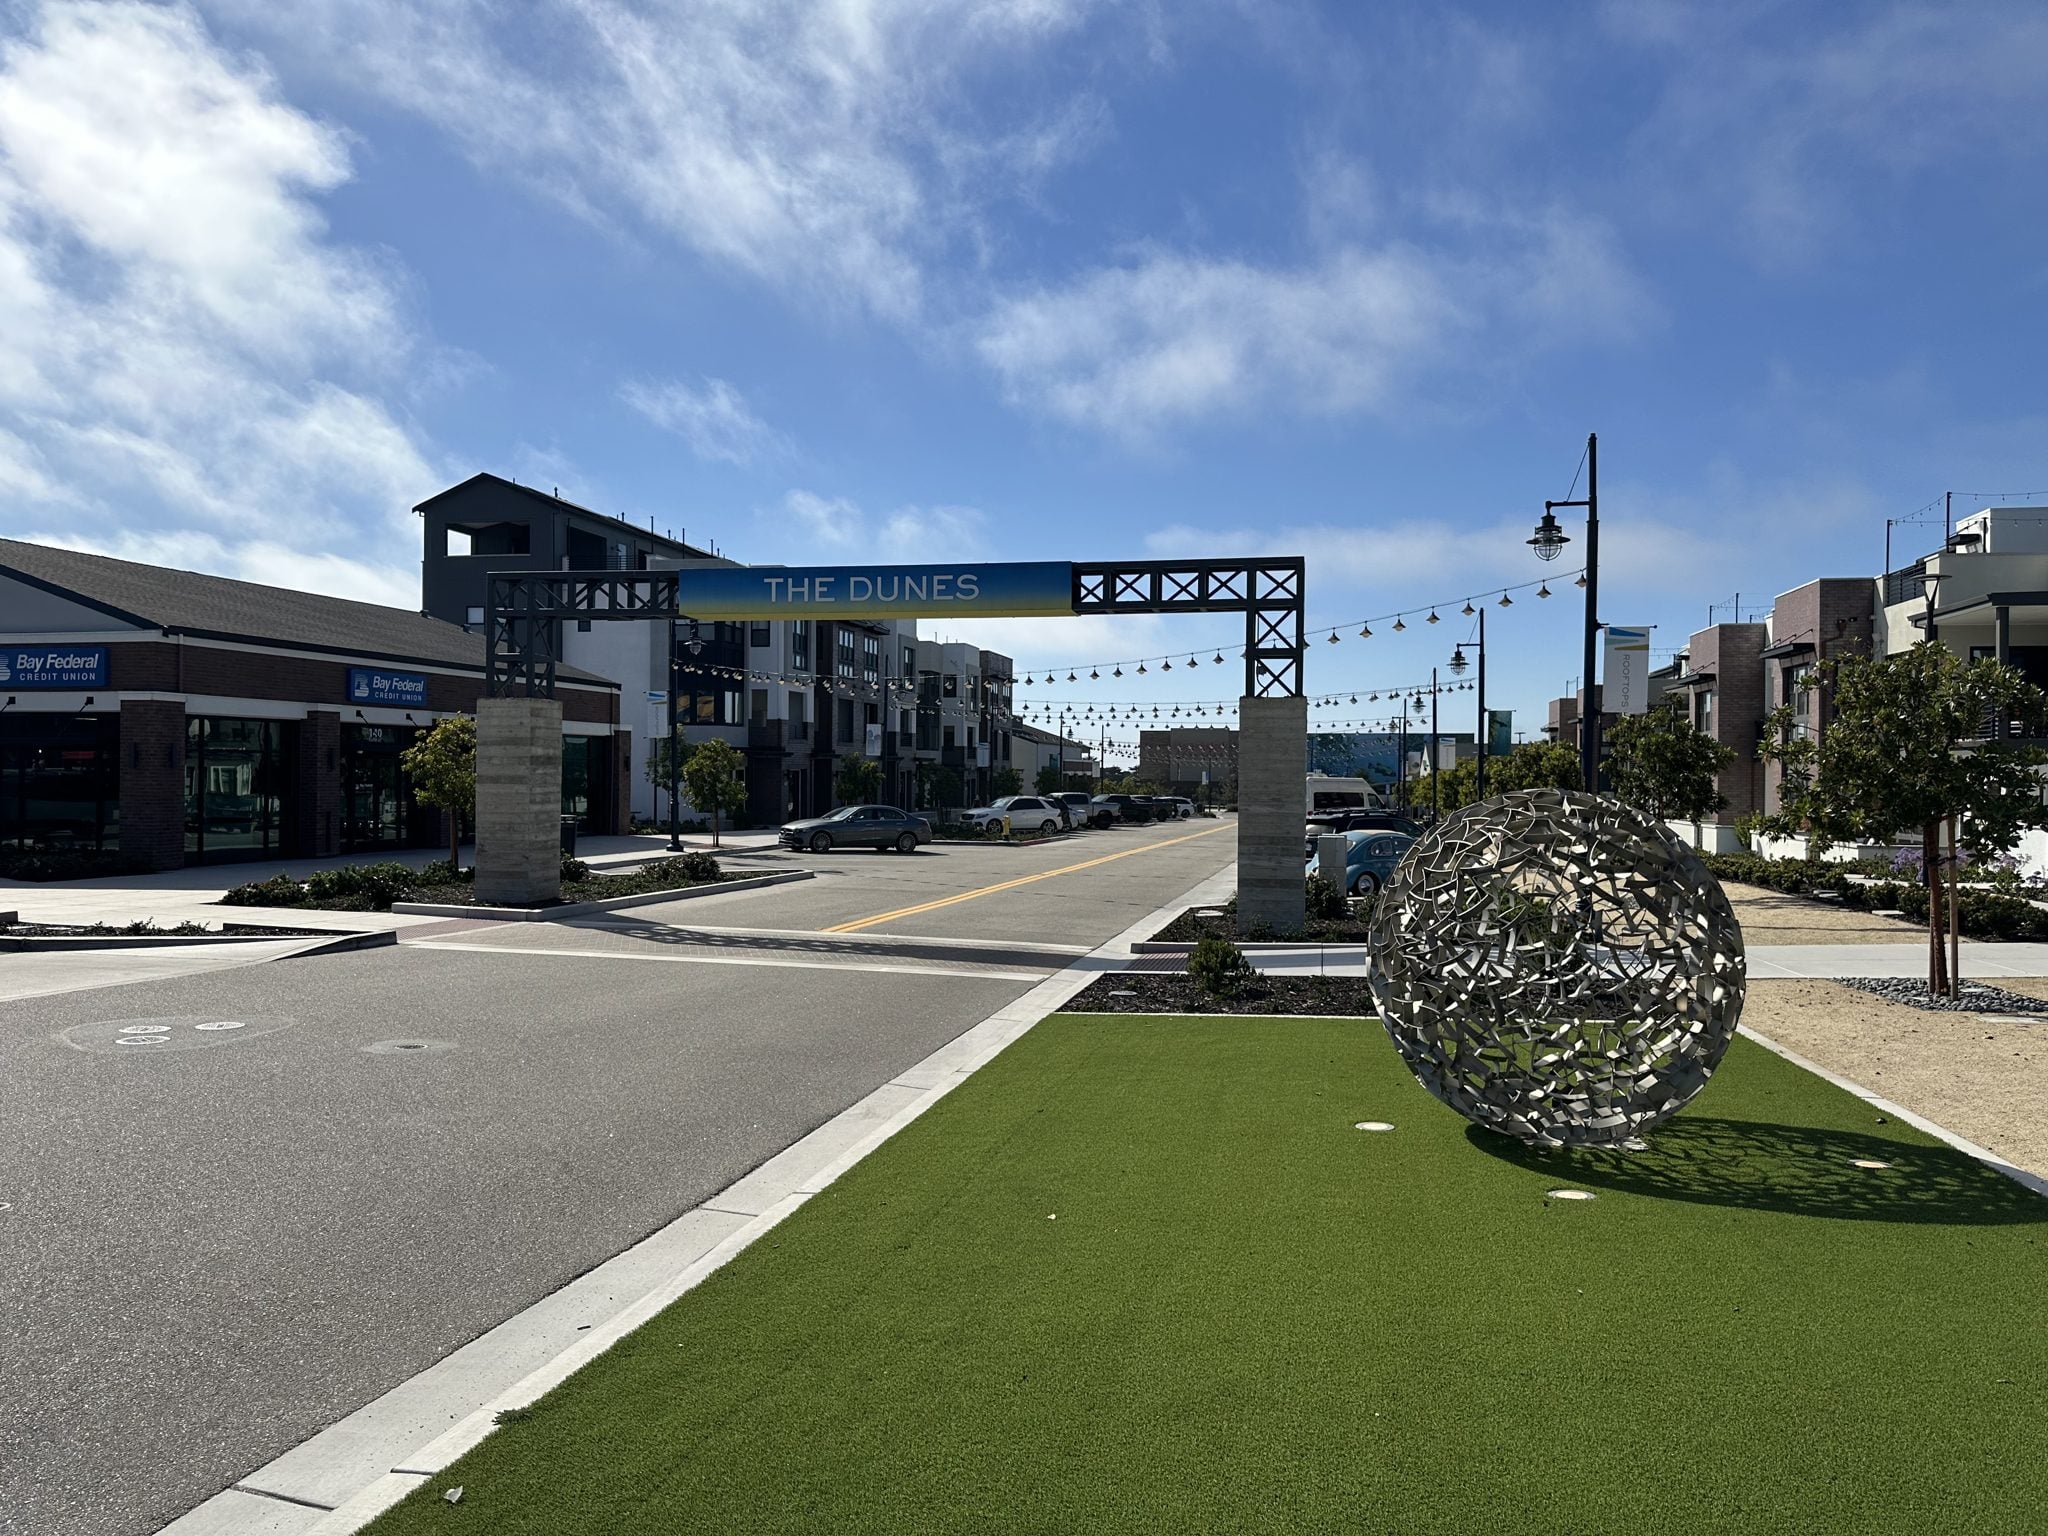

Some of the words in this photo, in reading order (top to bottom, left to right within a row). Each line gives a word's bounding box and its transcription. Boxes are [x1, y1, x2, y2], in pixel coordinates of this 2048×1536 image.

[763, 577, 835, 602] THE
[849, 574, 980, 601] DUNES
[16, 654, 44, 672] Bay
[46, 653, 99, 669] Federal
[62, 672, 96, 680] UNION
[373, 676, 391, 692] Bay
[392, 677, 424, 692] Federal
[1621, 654, 1631, 708] ROOFTOPS
[374, 692, 399, 700] CREDIT
